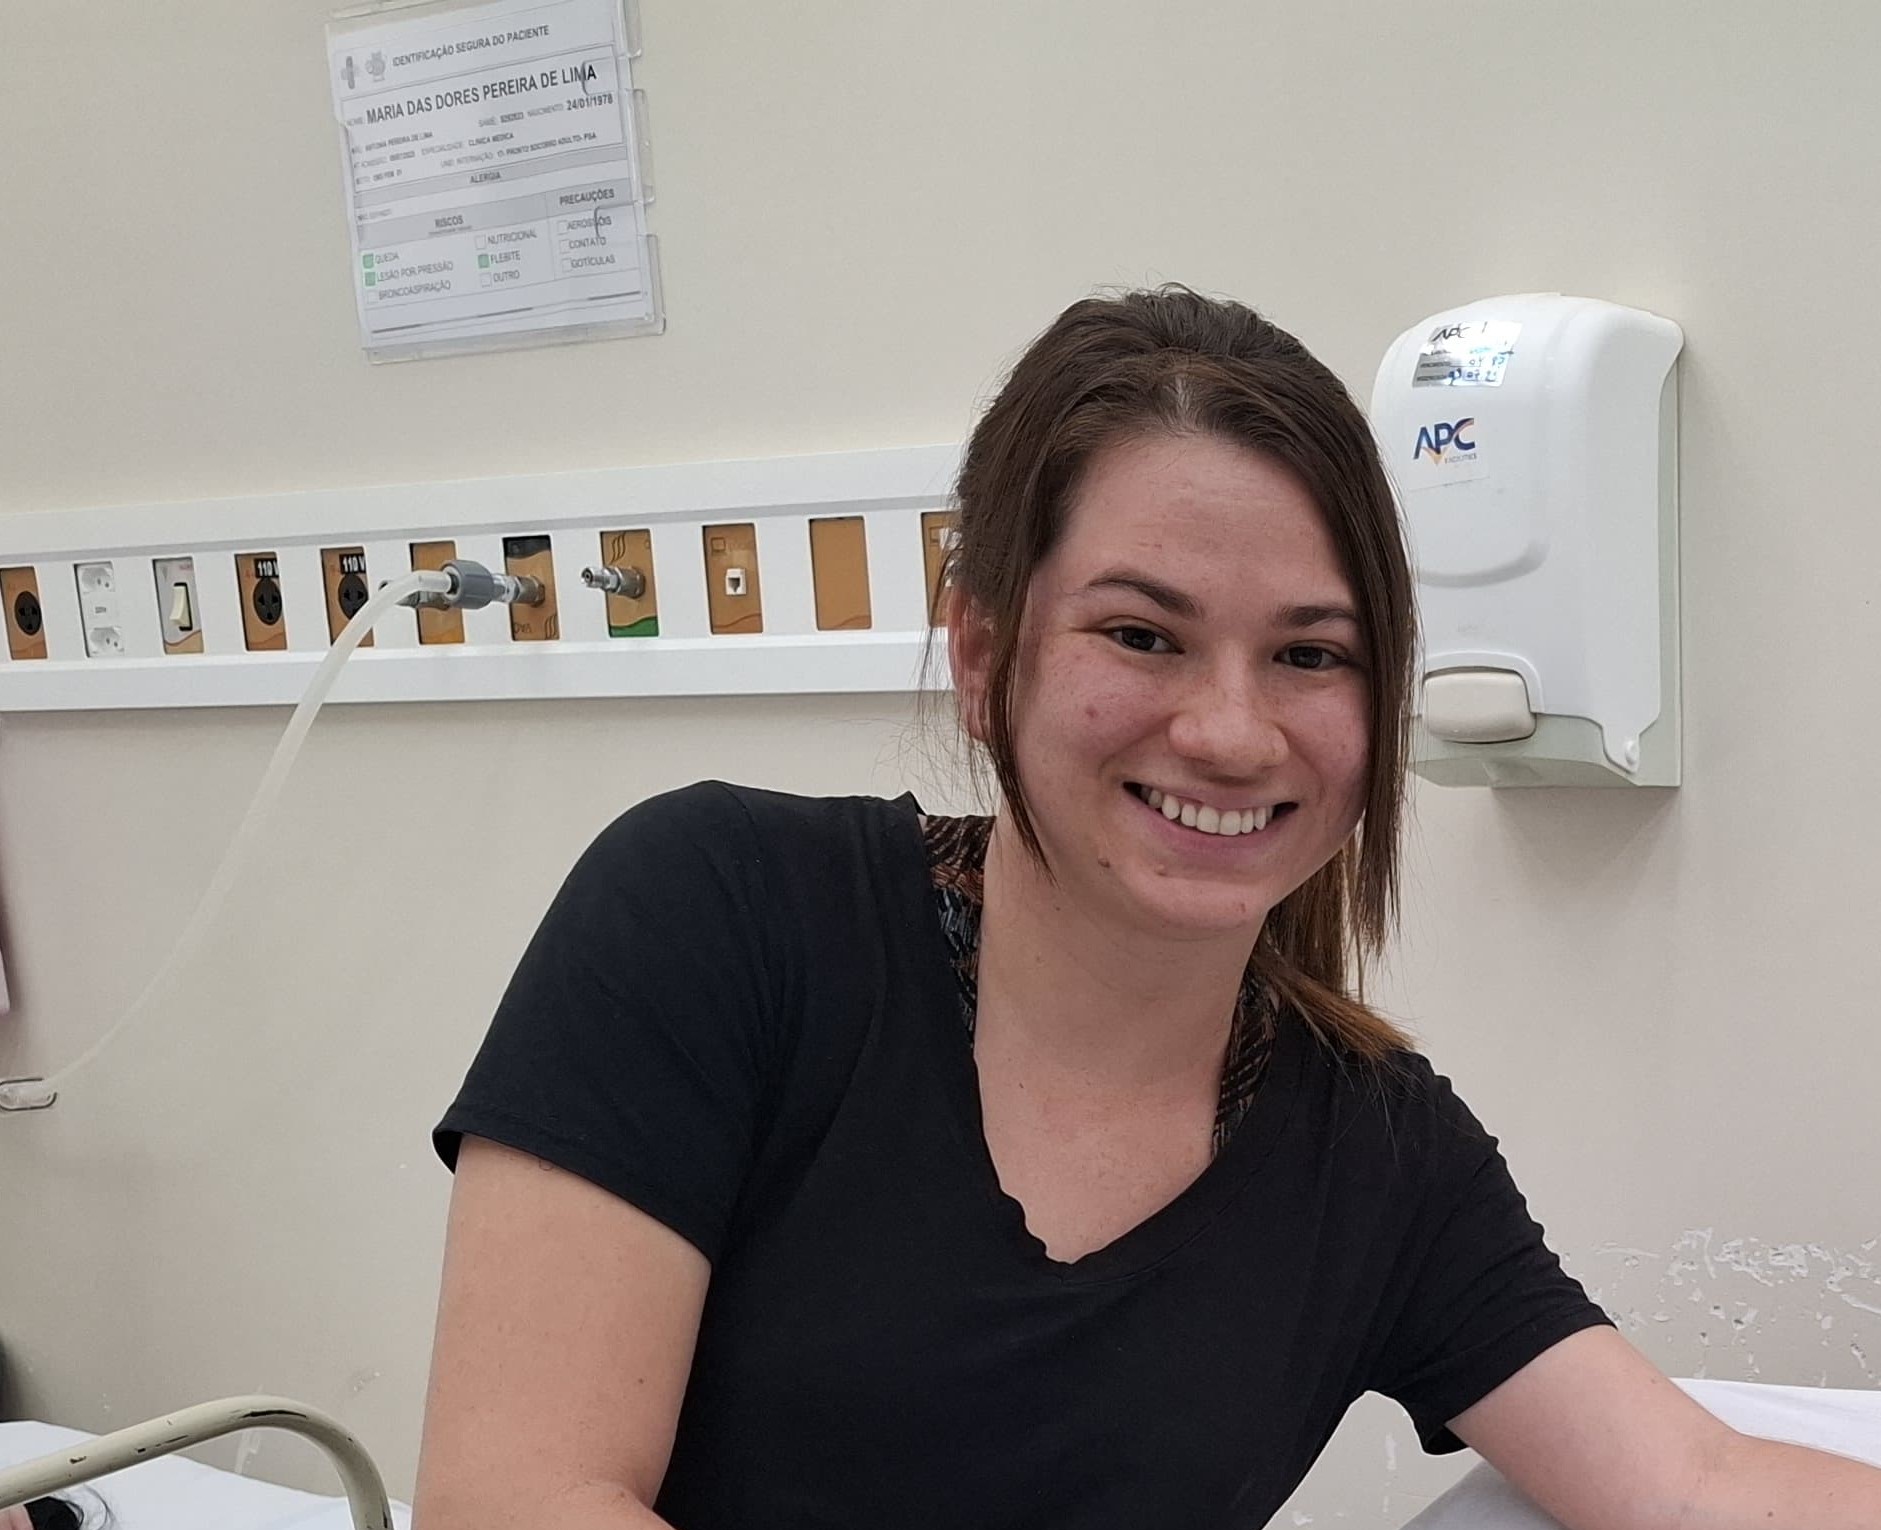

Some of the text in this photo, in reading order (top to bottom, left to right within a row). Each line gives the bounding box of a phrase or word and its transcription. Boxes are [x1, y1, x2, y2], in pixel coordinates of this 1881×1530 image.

[392, 25, 550, 68] IDENTIFICAÇÃO SEGURA DO PACIENTE
[366, 101, 404, 124] MARIA
[406, 96, 433, 116] DAS
[435, 87, 480, 110] DORES
[483, 74, 538, 101] PEREIRA
[540, 69, 559, 89] DE
[562, 64, 598, 84] LIMA
[470, 171, 501, 184] ALERGIA
[559, 188, 615, 205] PRECAUÇÕES
[435, 215, 464, 228] RISCOS
[487, 229, 538, 245] NUTRICIONAL
[569, 236, 607, 249] CONTATO
[490, 250, 521, 264] FLEBITE
[571, 254, 616, 269] GOTÍCULAS
[401, 266, 416, 278] POR
[417, 260, 454, 275] PRESSÃO
[493, 269, 520, 283] OUTRO
[1413, 417, 1476, 461] APC
[257, 560, 273, 577] 110
[342, 555, 358, 573] 110
